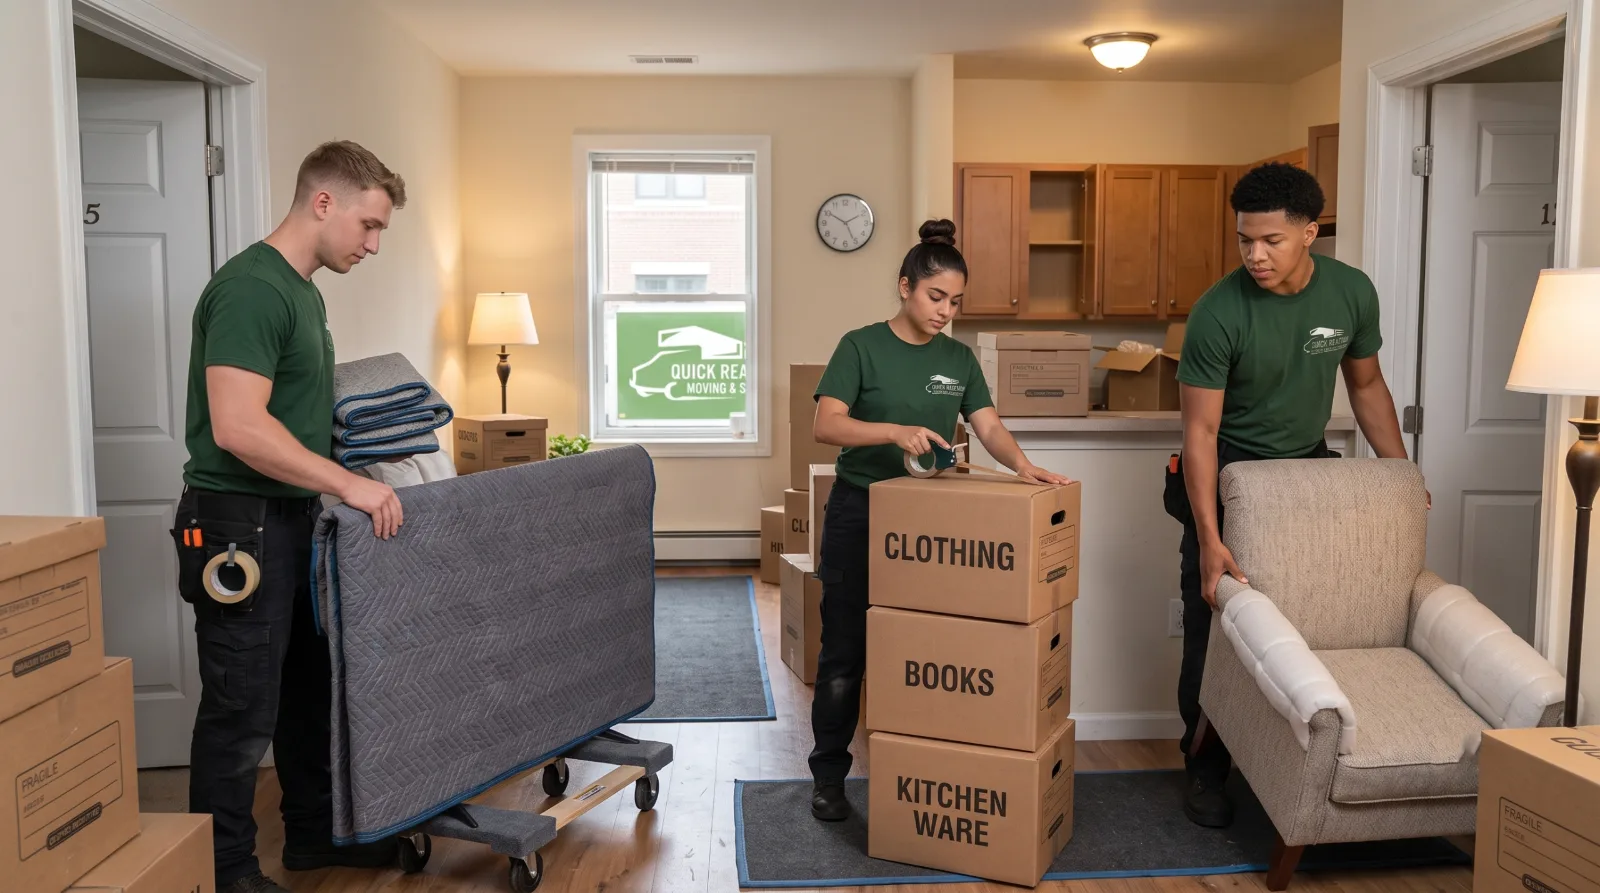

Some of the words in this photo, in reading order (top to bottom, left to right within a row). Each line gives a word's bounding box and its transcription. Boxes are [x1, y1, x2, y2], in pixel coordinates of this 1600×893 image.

[83, 203, 101, 225] 5
[671, 364, 716, 380] QUICK
[686, 382, 726, 394] MOVING
[729, 382, 736, 394] &
[884, 532, 1014, 572] CLOTHING
[905, 660, 994, 697] BOOKS
[22, 761, 59, 793] FRAGILE
[897, 775, 1007, 818] KITCHEN
[913, 810, 989, 848] WARE
[1504, 805, 1543, 833] FRAGILE
